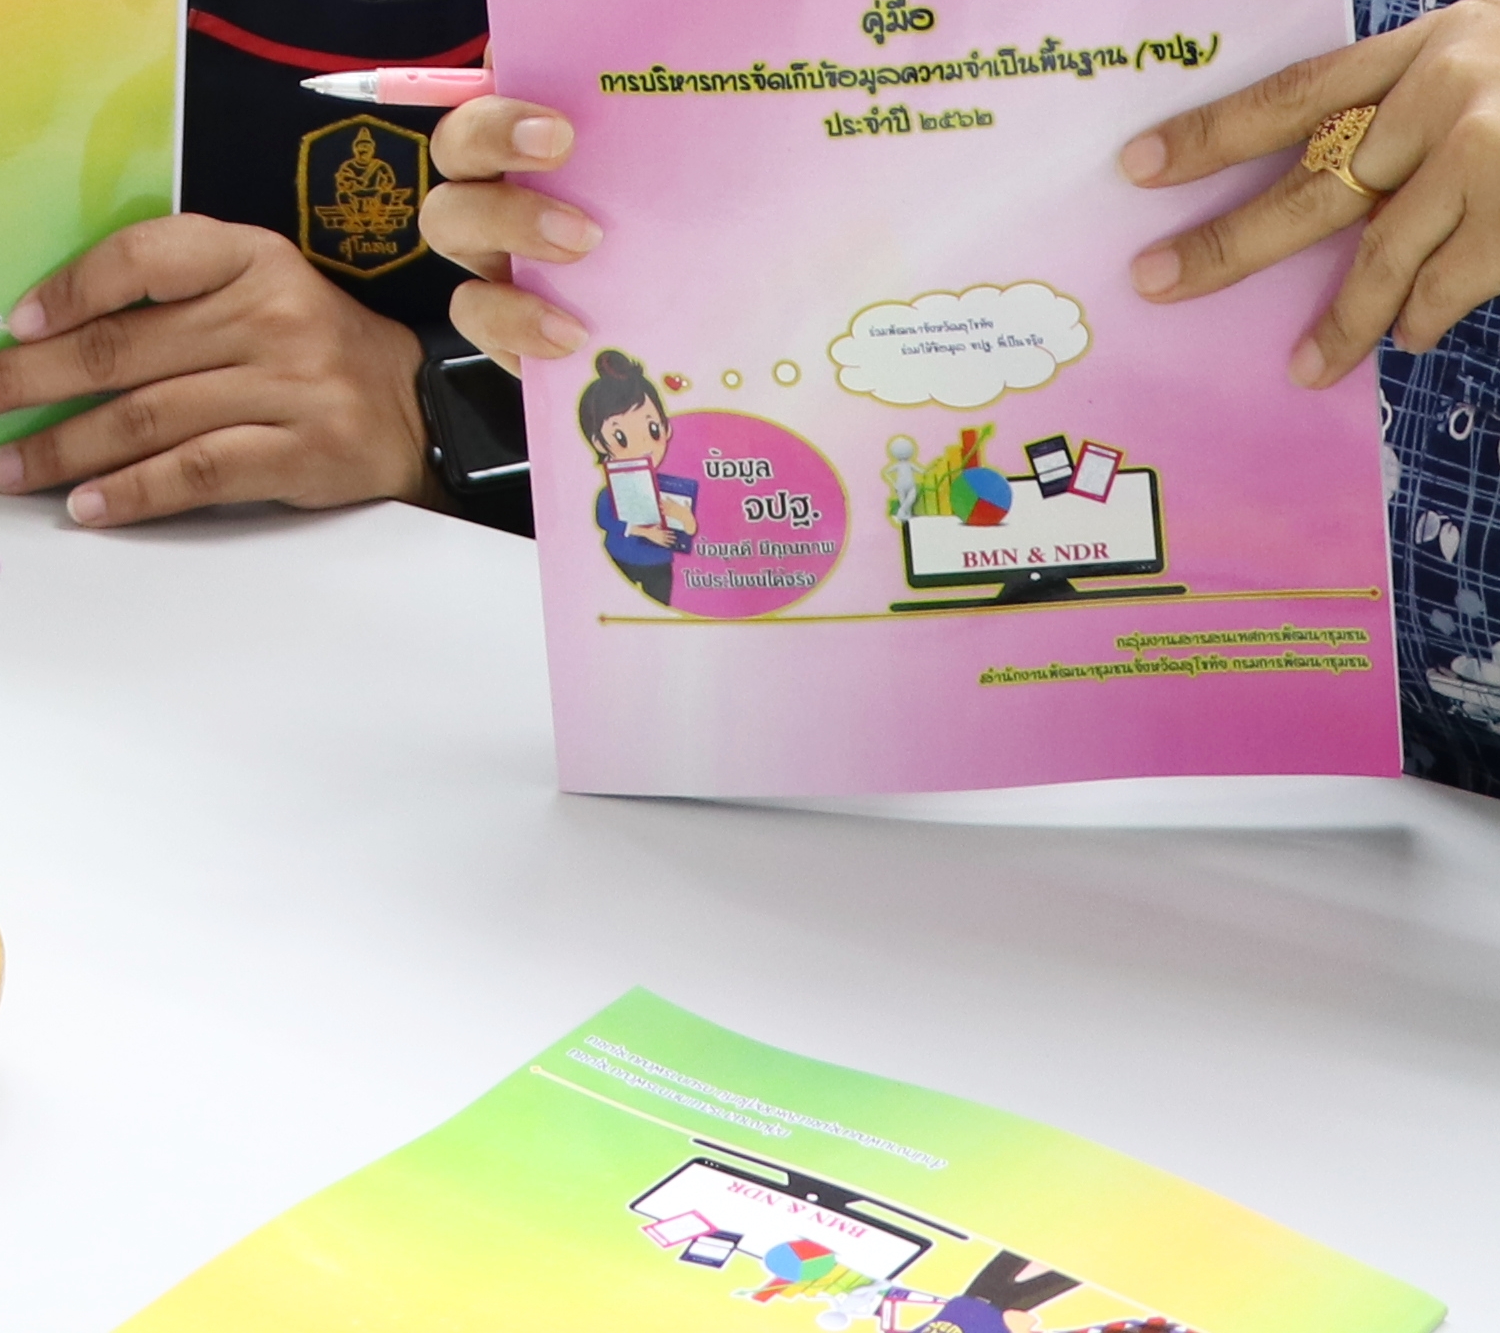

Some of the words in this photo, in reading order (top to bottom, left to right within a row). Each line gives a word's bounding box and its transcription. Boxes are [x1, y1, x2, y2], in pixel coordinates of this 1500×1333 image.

[825, 104, 911, 137] ประจำปี
[704, 449, 772, 484] ข้อมูล
[744, 492, 820, 527] จปฐ.
[962, 548, 1018, 569] BMN
[1027, 546, 1047, 564] &
[1054, 542, 1110, 563] NDR
[726, 1179, 777, 1207] NDR
[786, 1200, 809, 1215] &
[809, 1210, 868, 1239] BMN
